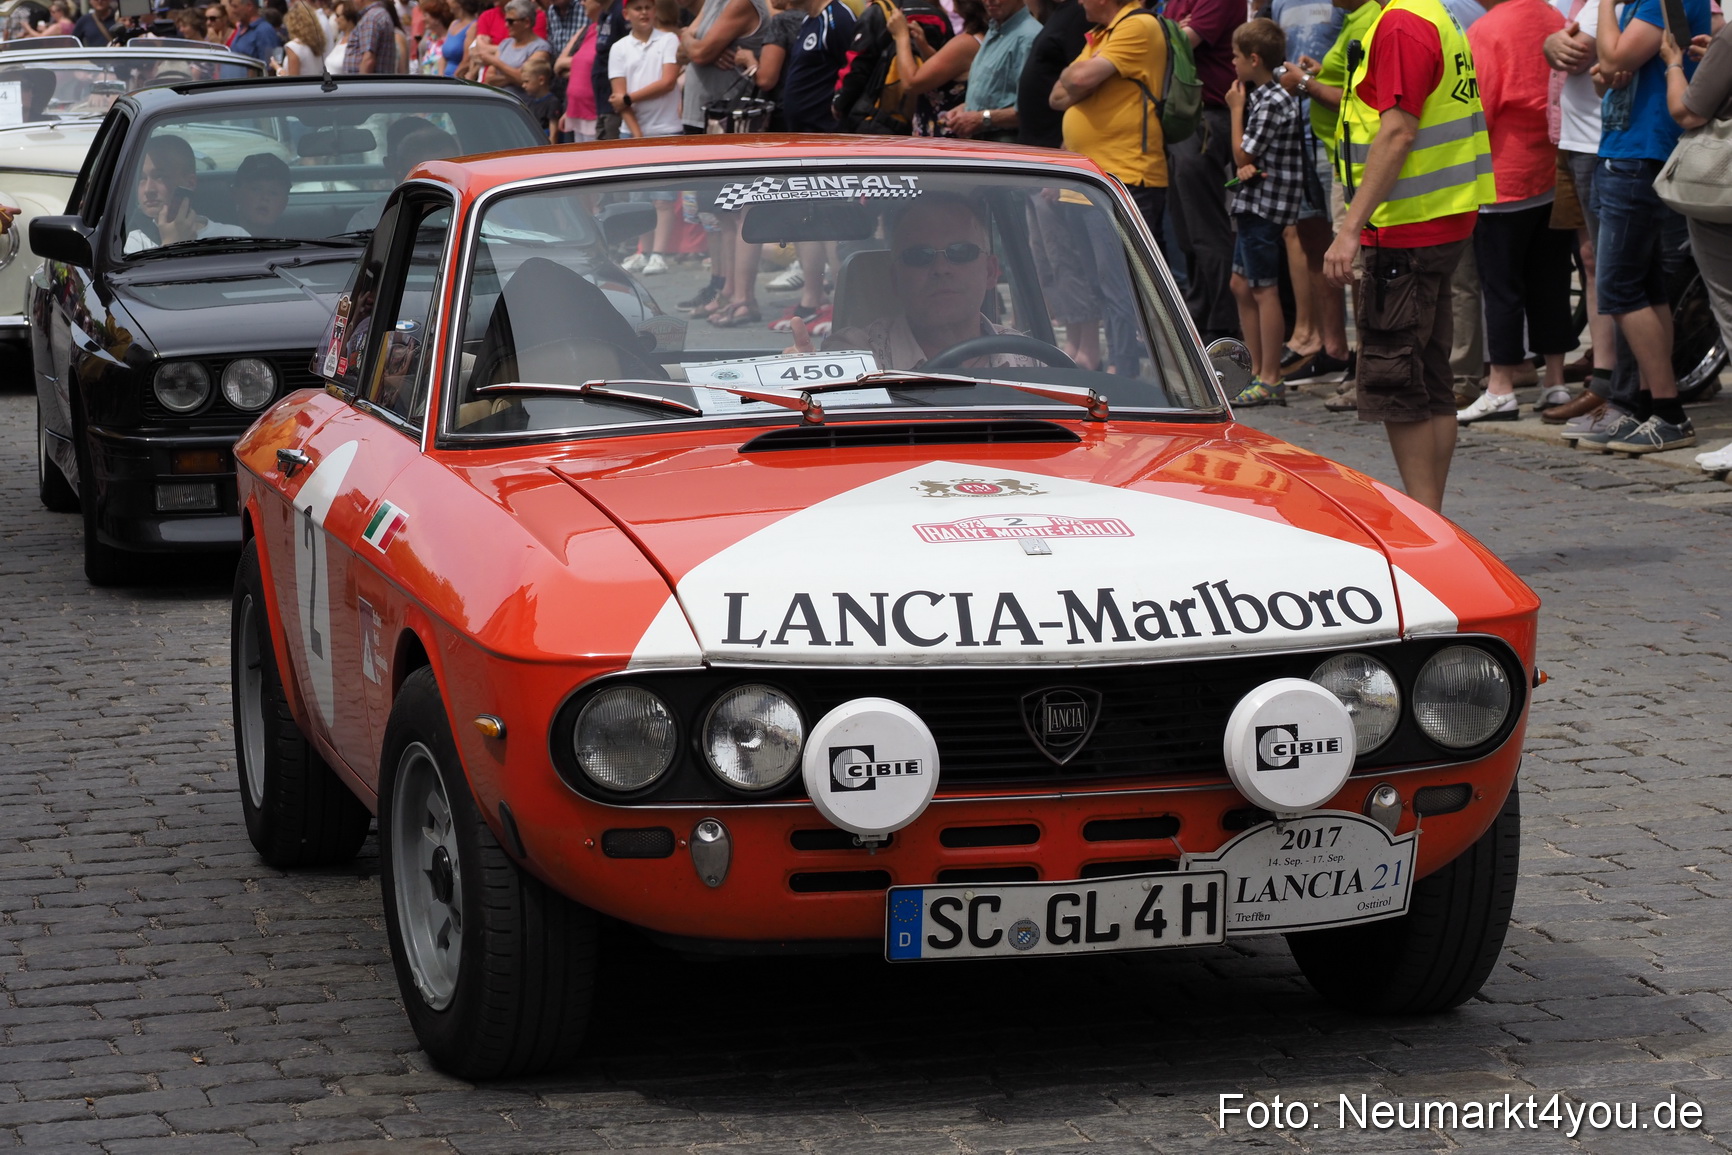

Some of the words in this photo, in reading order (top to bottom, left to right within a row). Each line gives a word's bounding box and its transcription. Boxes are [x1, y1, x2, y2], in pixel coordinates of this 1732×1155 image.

[786, 175, 919, 191] EINFALT
[751, 190, 846, 201] MOTORSPORT
[780, 363, 844, 381] 450
[923, 526, 993, 541] RALLYE
[992, 521, 1122, 538] MONTE-CARLO
[954, 519, 985, 529] 1973
[1003, 517, 1028, 526] 2
[721, 579, 1383, 649] LANCIA-Marlboro
[1048, 706, 1083, 732] LANCIA
[1280, 826, 1342, 850] 2017
[1284, 857, 1303, 867] Sep.
[1327, 854, 1346, 864] Sep.
[1233, 867, 1364, 903] LANCIA
[1370, 859, 1402, 891] 21
[1357, 896, 1391, 911] Osttirol
[927, 895, 1003, 949] SC
[1045, 890, 1120, 945] GL
[1235, 911, 1271, 922] Treffen
[899, 932, 911, 947] D
